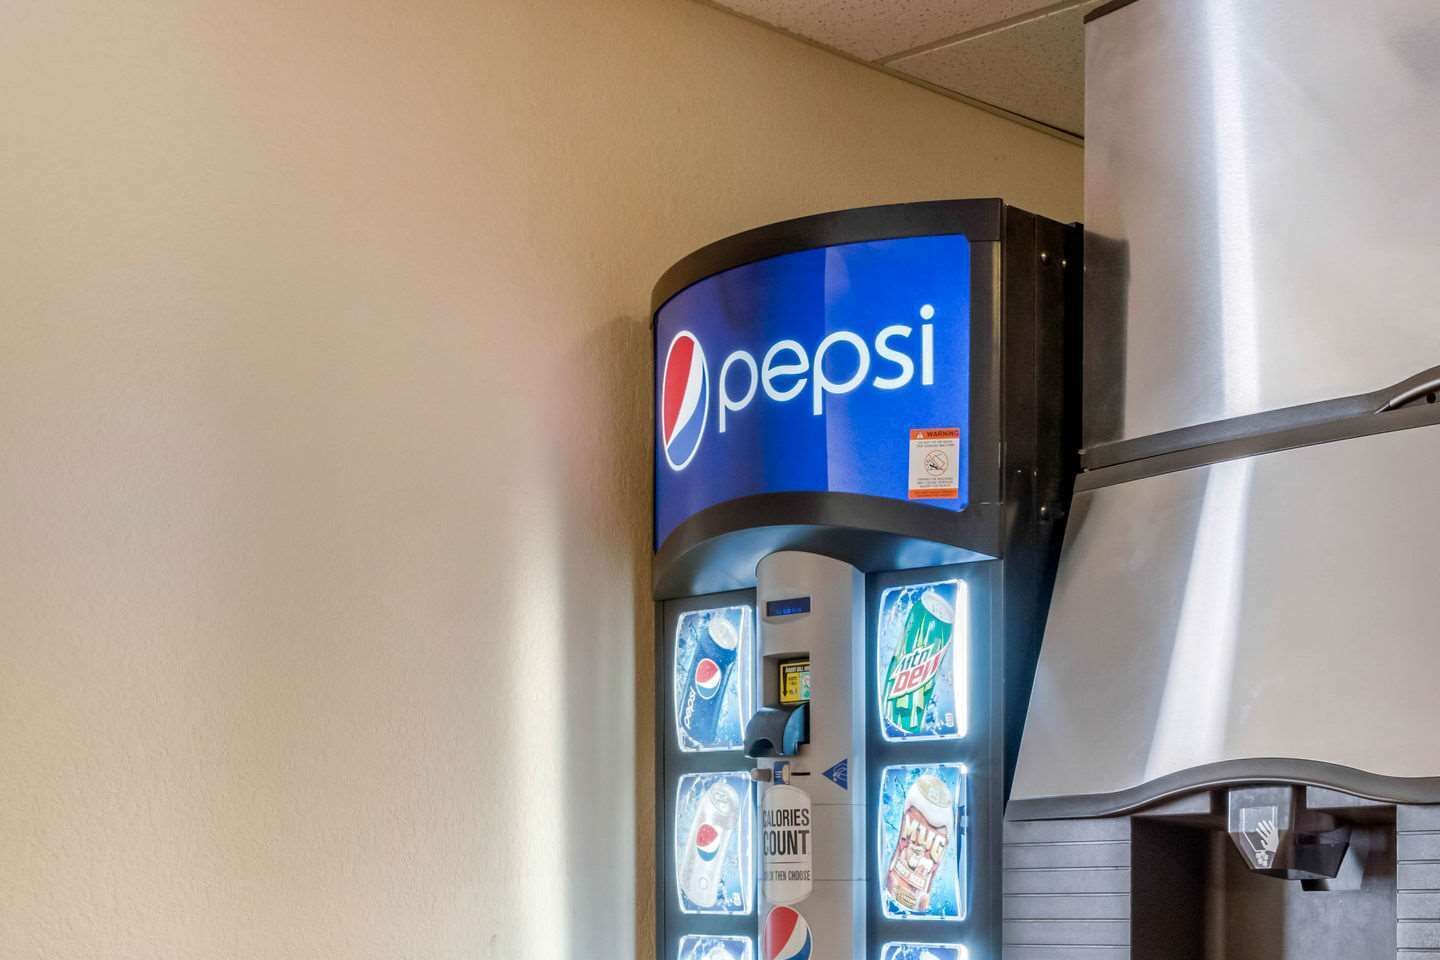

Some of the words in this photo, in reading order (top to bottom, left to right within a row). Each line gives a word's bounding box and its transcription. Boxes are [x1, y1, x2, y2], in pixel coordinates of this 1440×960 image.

[719, 304, 935, 433] pepsi
[762, 808, 810, 828] CALORIES
[763, 830, 810, 856] COUNT
[904, 812, 947, 865] MUG
